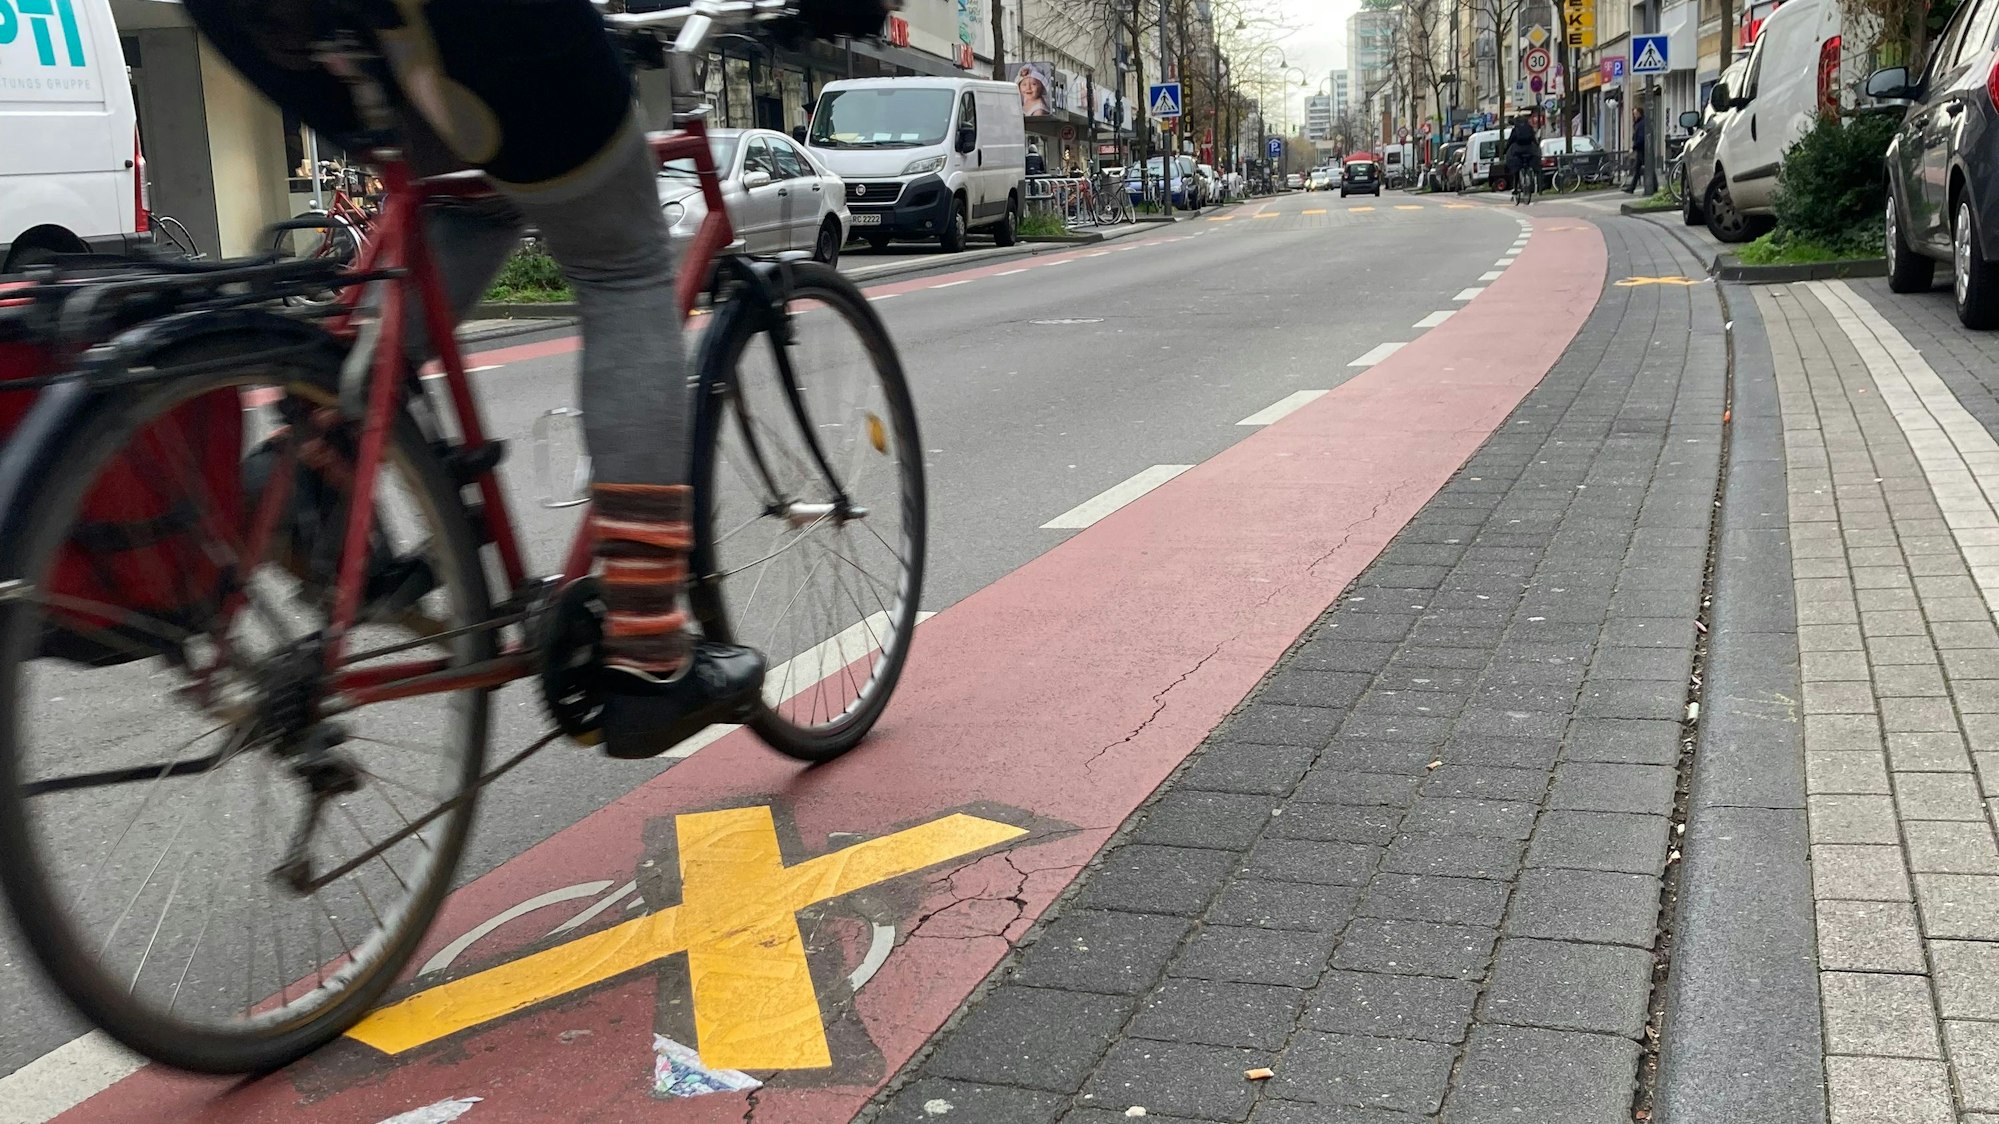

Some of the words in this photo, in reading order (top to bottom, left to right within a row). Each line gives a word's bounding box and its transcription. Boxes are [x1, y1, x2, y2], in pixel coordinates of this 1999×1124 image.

[1531, 56, 1545, 67] 30
[1614, 61, 1621, 75] P
[47, 78, 91, 90] GRUPPE
[1271, 142, 1278, 152] P
